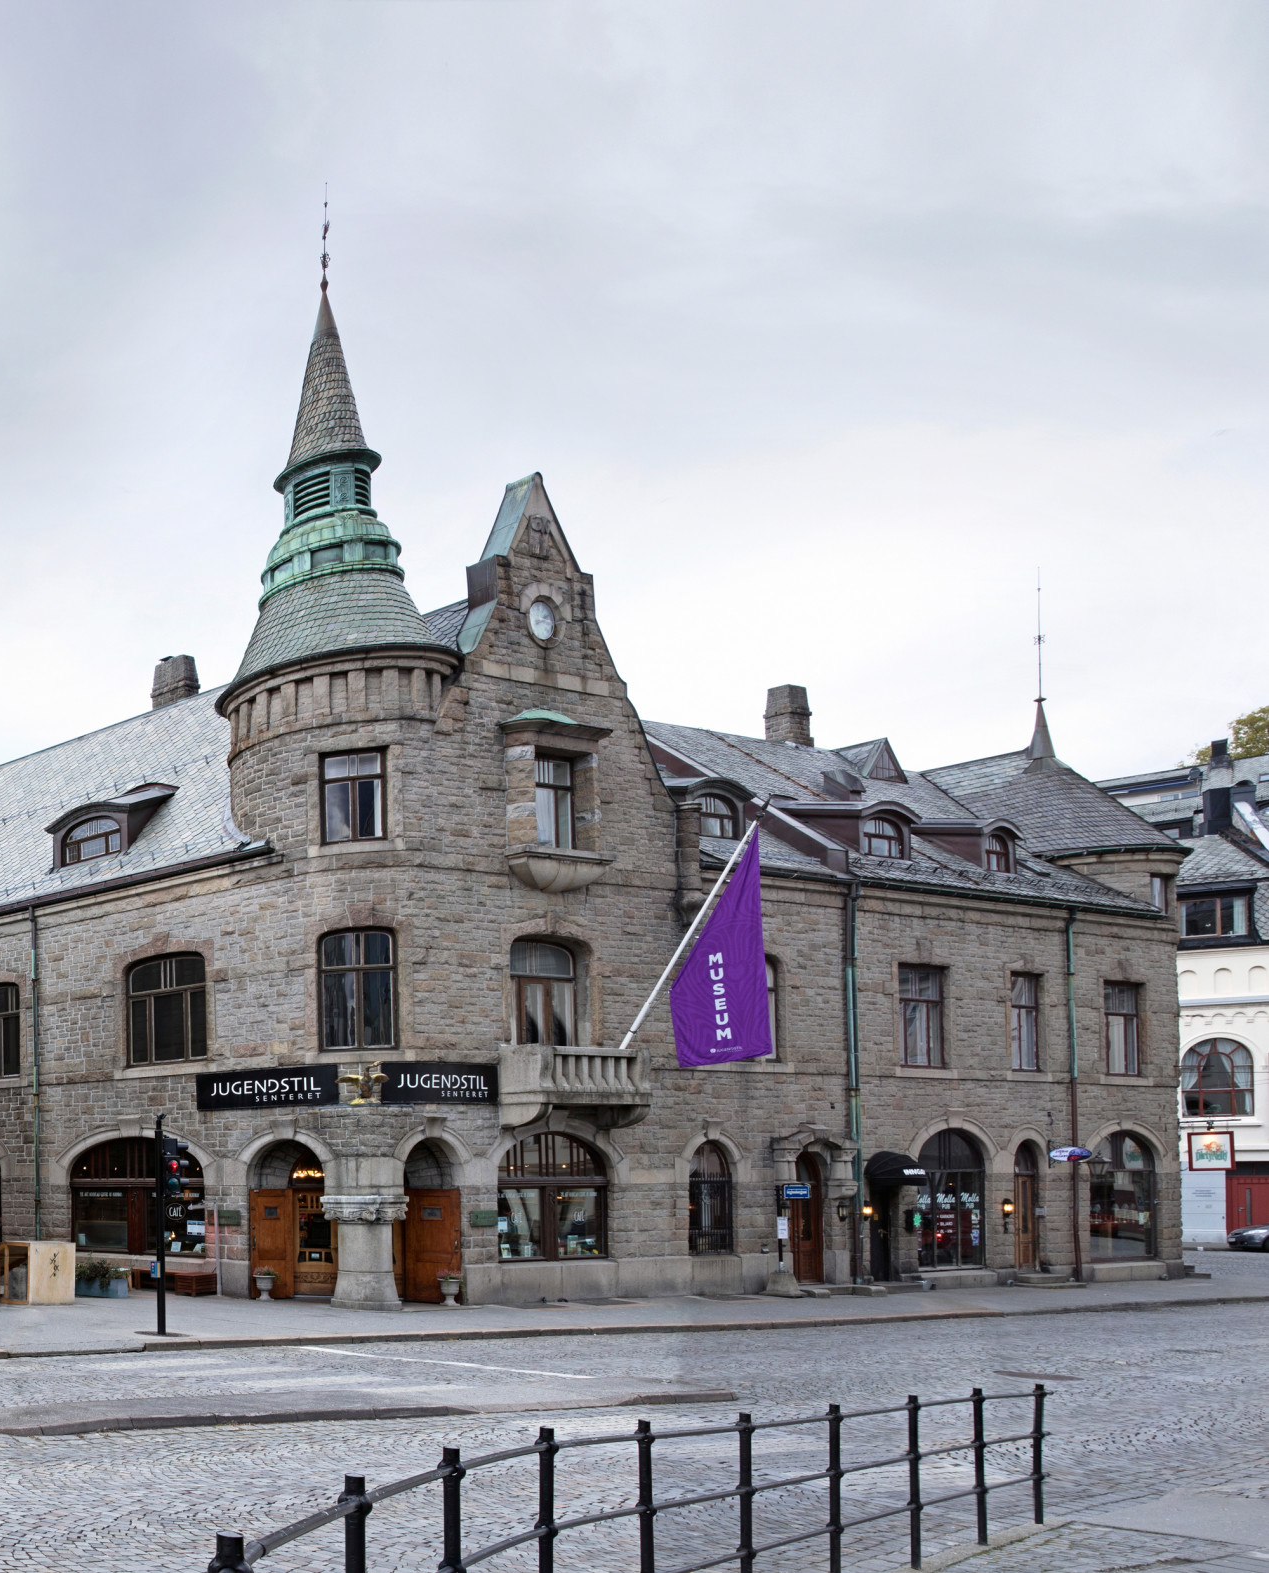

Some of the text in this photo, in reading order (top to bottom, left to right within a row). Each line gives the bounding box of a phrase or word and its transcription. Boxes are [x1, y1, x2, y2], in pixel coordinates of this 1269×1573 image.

[708, 952, 732, 1041] MUSEUM
[210, 1076, 322, 1097] JUGENDSTIL
[397, 1073, 489, 1090] JUGENDSTIL
[255, 1092, 322, 1103] SENTERET
[441, 1090, 489, 1098] SENTERET
[960, 1192, 979, 1202] Molla
